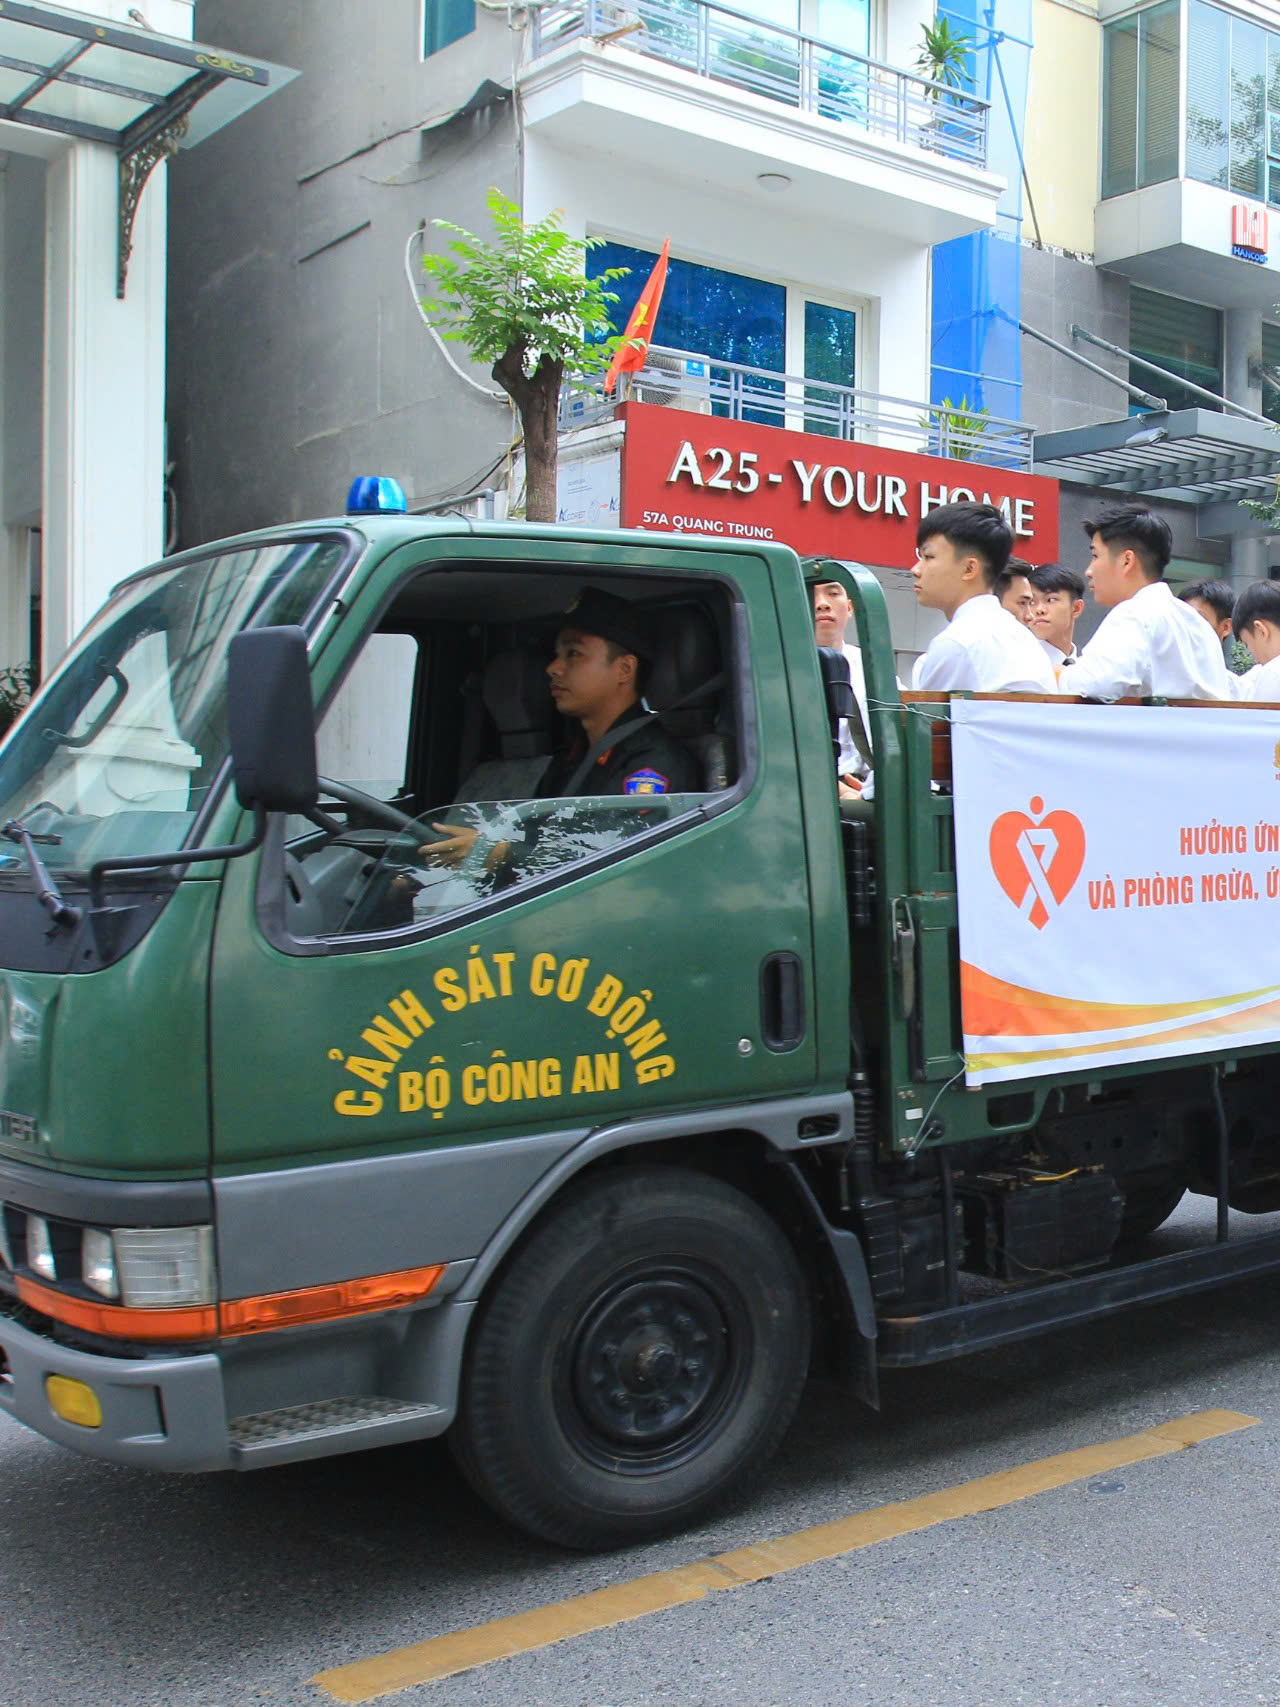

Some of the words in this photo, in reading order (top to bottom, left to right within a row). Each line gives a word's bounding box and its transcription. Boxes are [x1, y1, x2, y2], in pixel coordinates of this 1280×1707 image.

[1232, 246, 1269, 264] HANCORP
[666, 441, 760, 494] A25
[791, 459, 910, 518] YOUR
[643, 511, 669, 526] 57A
[672, 514, 724, 534] QUANG
[727, 522, 774, 540] TRUNG
[1179, 818, 1247, 856] HƯỞNG
[1088, 874, 1116, 910] VÀ
[1124, 872, 1193, 908] PHÒNG
[1201, 867, 1259, 903] NGỪA,
[328, 989, 436, 1118] CẢNH
[433, 944, 517, 1013] SÁT
[529, 952, 591, 1003] CƠ
[586, 972, 677, 1086] ĐỘNG
[399, 1055, 452, 1120] BỘ
[461, 1049, 562, 1106] CÔNG
[571, 1052, 620, 1095] AN
